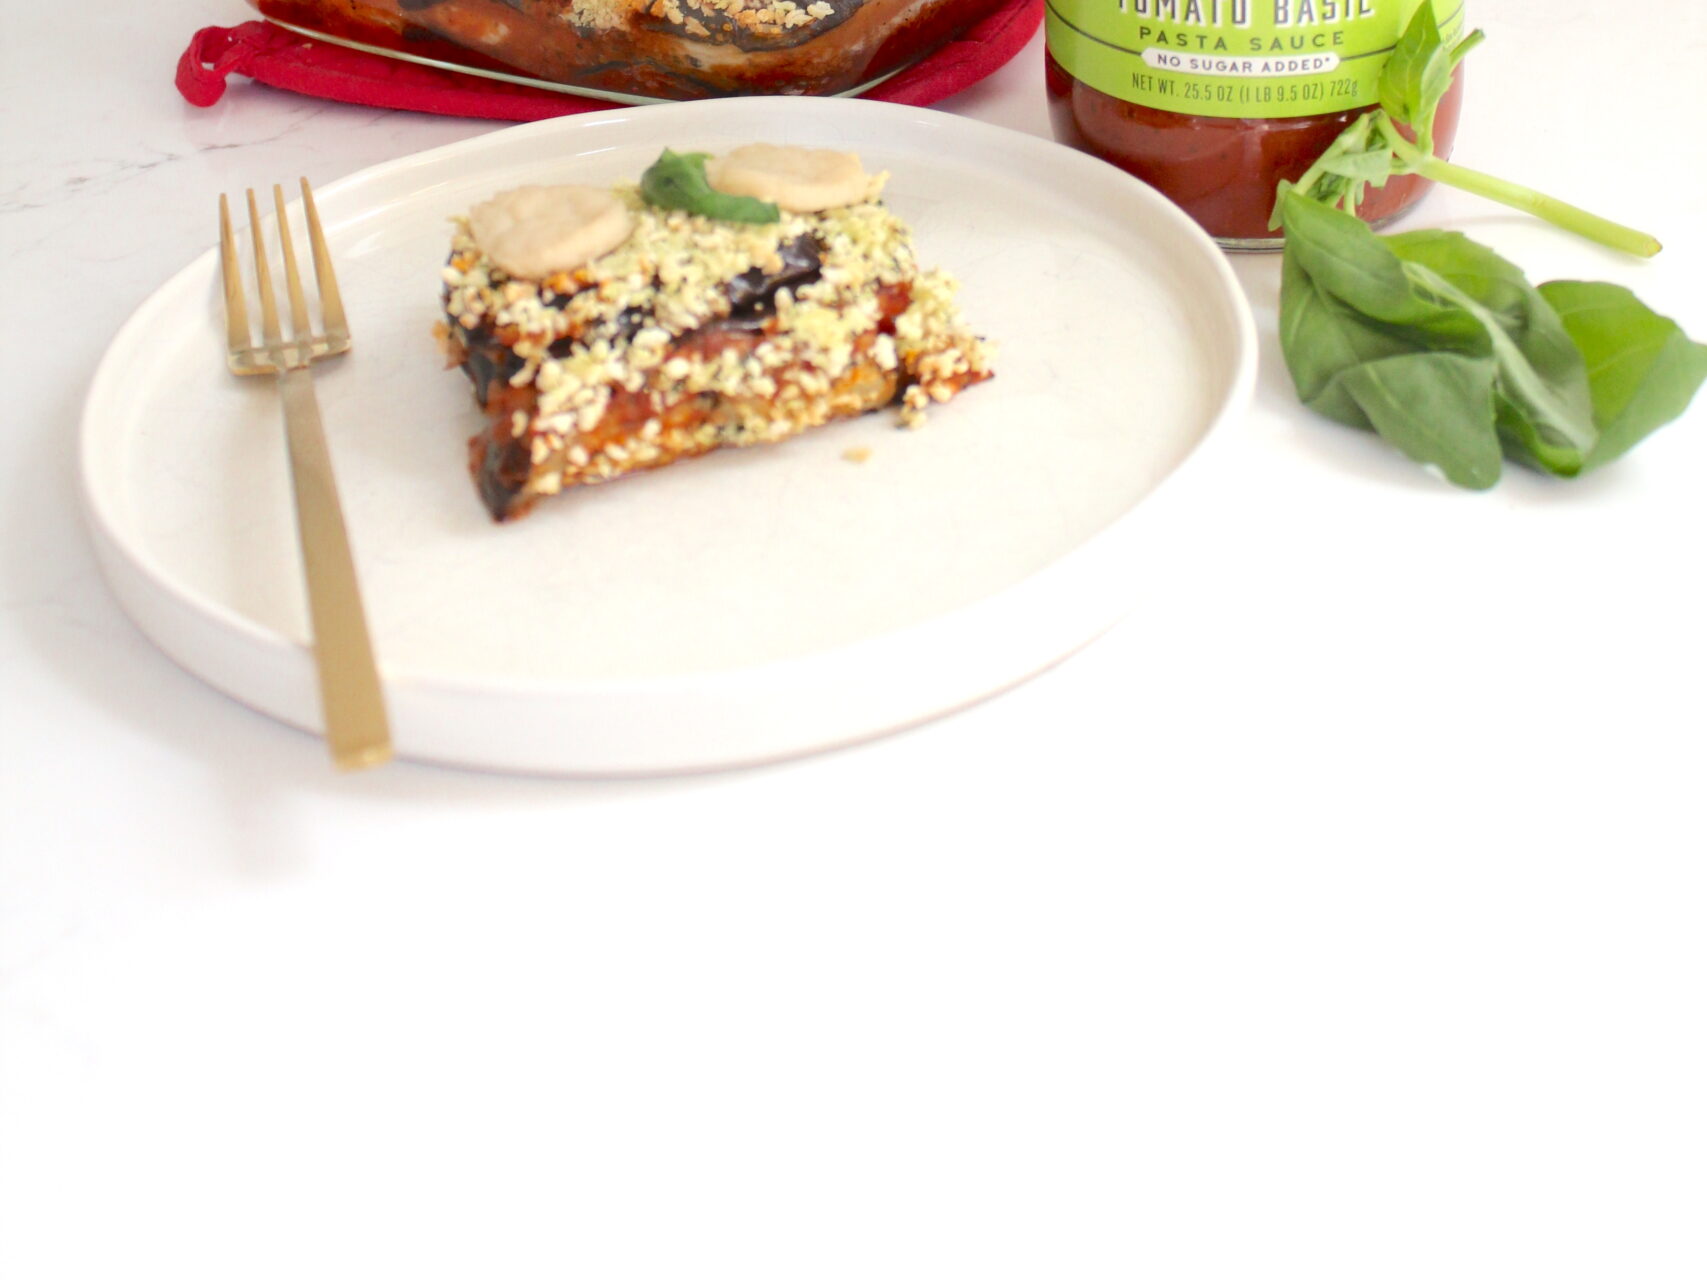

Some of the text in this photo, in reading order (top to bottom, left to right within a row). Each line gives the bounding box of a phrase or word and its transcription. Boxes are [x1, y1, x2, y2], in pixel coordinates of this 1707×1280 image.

[1139, 26, 1345, 52] PASTA SAUCE
[1157, 53, 1181, 68] NO
[1189, 58, 1253, 73] SUGAR
[1132, 72, 1153, 91] NET
[1157, 78, 1180, 97] WT.
[1184, 82, 1212, 101] 25.5
[1216, 86, 1233, 102] OZ
[1255, 86, 1272, 103] LB
[1276, 85, 1298, 102] 9.5
[1302, 82, 1325, 101] OZ)
[1329, 78, 1359, 97] 722g
